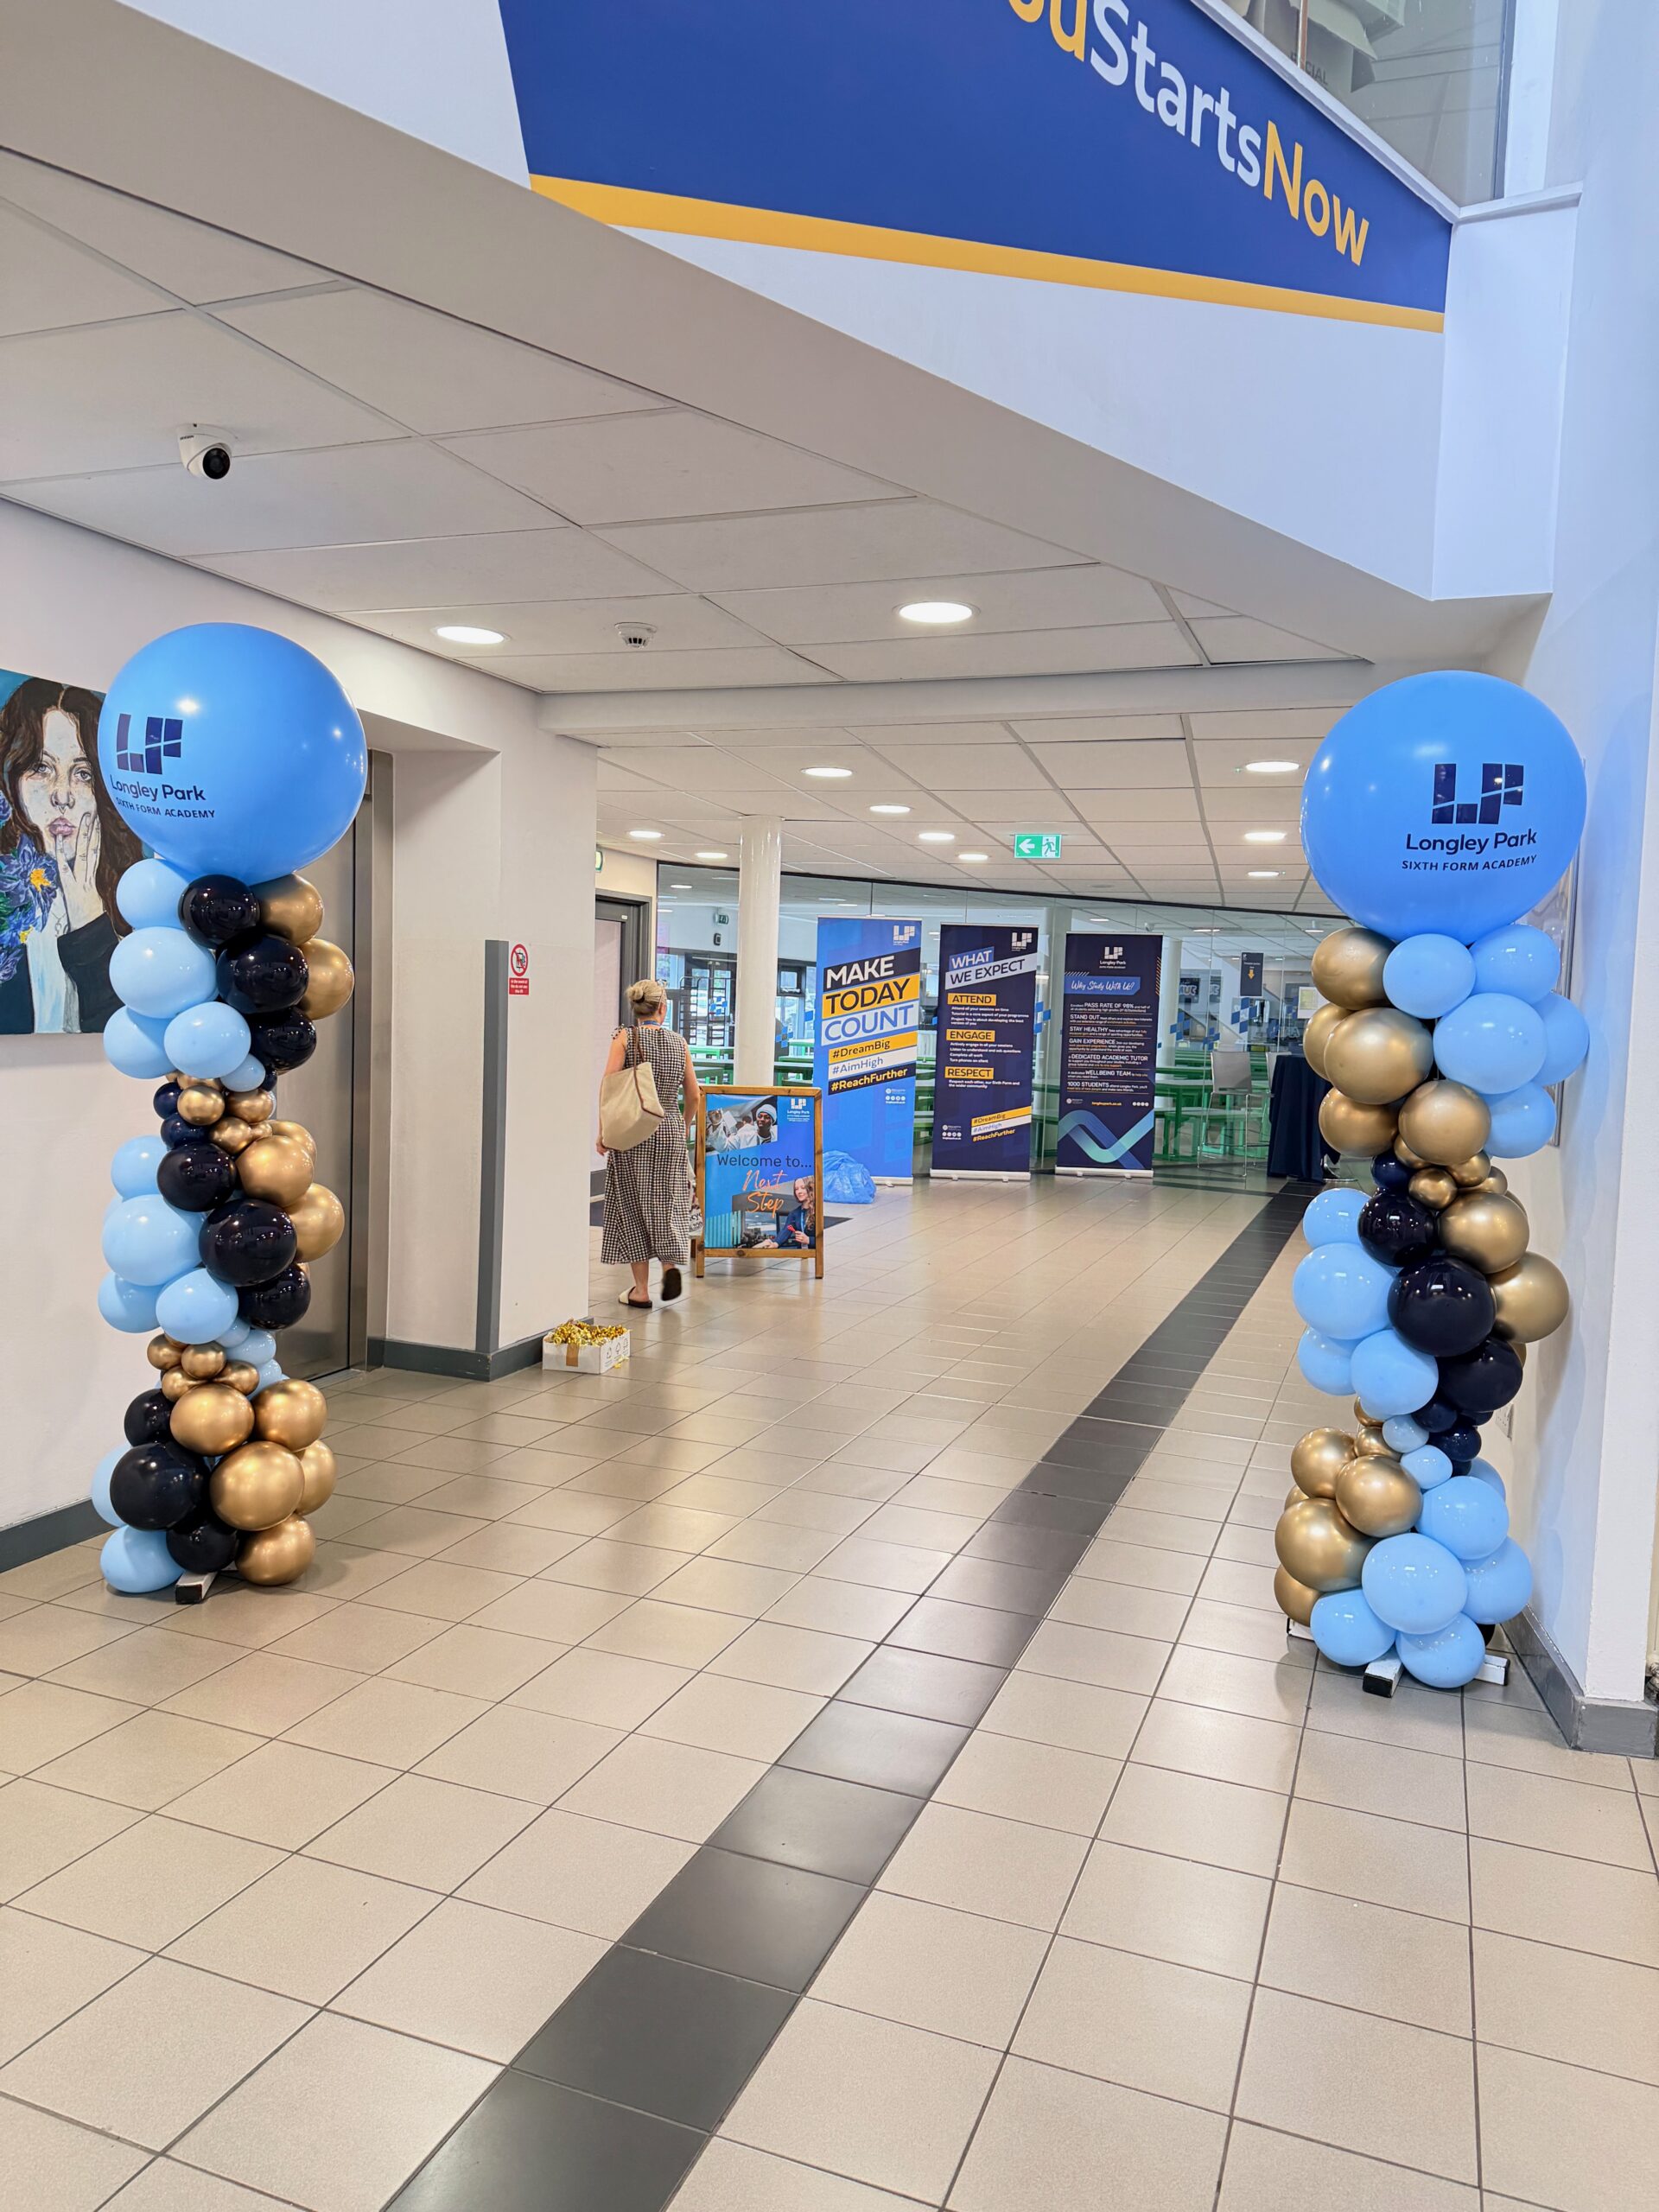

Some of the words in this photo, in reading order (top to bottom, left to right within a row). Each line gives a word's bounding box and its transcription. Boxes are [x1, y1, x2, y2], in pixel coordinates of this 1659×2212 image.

[110, 775, 158, 801] Longley
[162, 785, 207, 801] Park
[116, 797, 135, 810] SIXTH
[136, 804, 161, 816] FORM
[165, 809, 215, 818] ACADEMY
[1406, 834, 1489, 855] Longley
[1494, 828, 1537, 849] Park
[1402, 861, 1438, 871] SIXTH
[1443, 861, 1479, 871] FORM
[1482, 855, 1537, 871] ACADEMY
[952, 950, 992, 969] WHAT
[826, 955, 895, 989] MAKE
[950, 970, 972, 985] WE
[975, 959, 1025, 980] EXPECT
[1071, 980, 1086, 990] Why
[1087, 980, 1104, 990] Study
[826, 978, 911, 1014] TODAY
[952, 995, 992, 1004] ATTEND
[824, 1004, 914, 1041] COUNT
[950, 1031, 992, 1040] ENGAGE
[832, 1039, 890, 1058] #DreamBig
[832, 1057, 884, 1075] #AimHigh
[947, 1068, 991, 1077] RESPECT
[831, 1068, 908, 1092] #ReachFurther
[974, 1114, 1006, 1124] #DreamBig
[973, 1129, 1016, 1142] #ReachFurther
[717, 1154, 782, 1167] Welcome
[786, 1155, 812, 1168] to...
[742, 1169, 788, 1192] Next
[746, 1192, 784, 1218] Step
